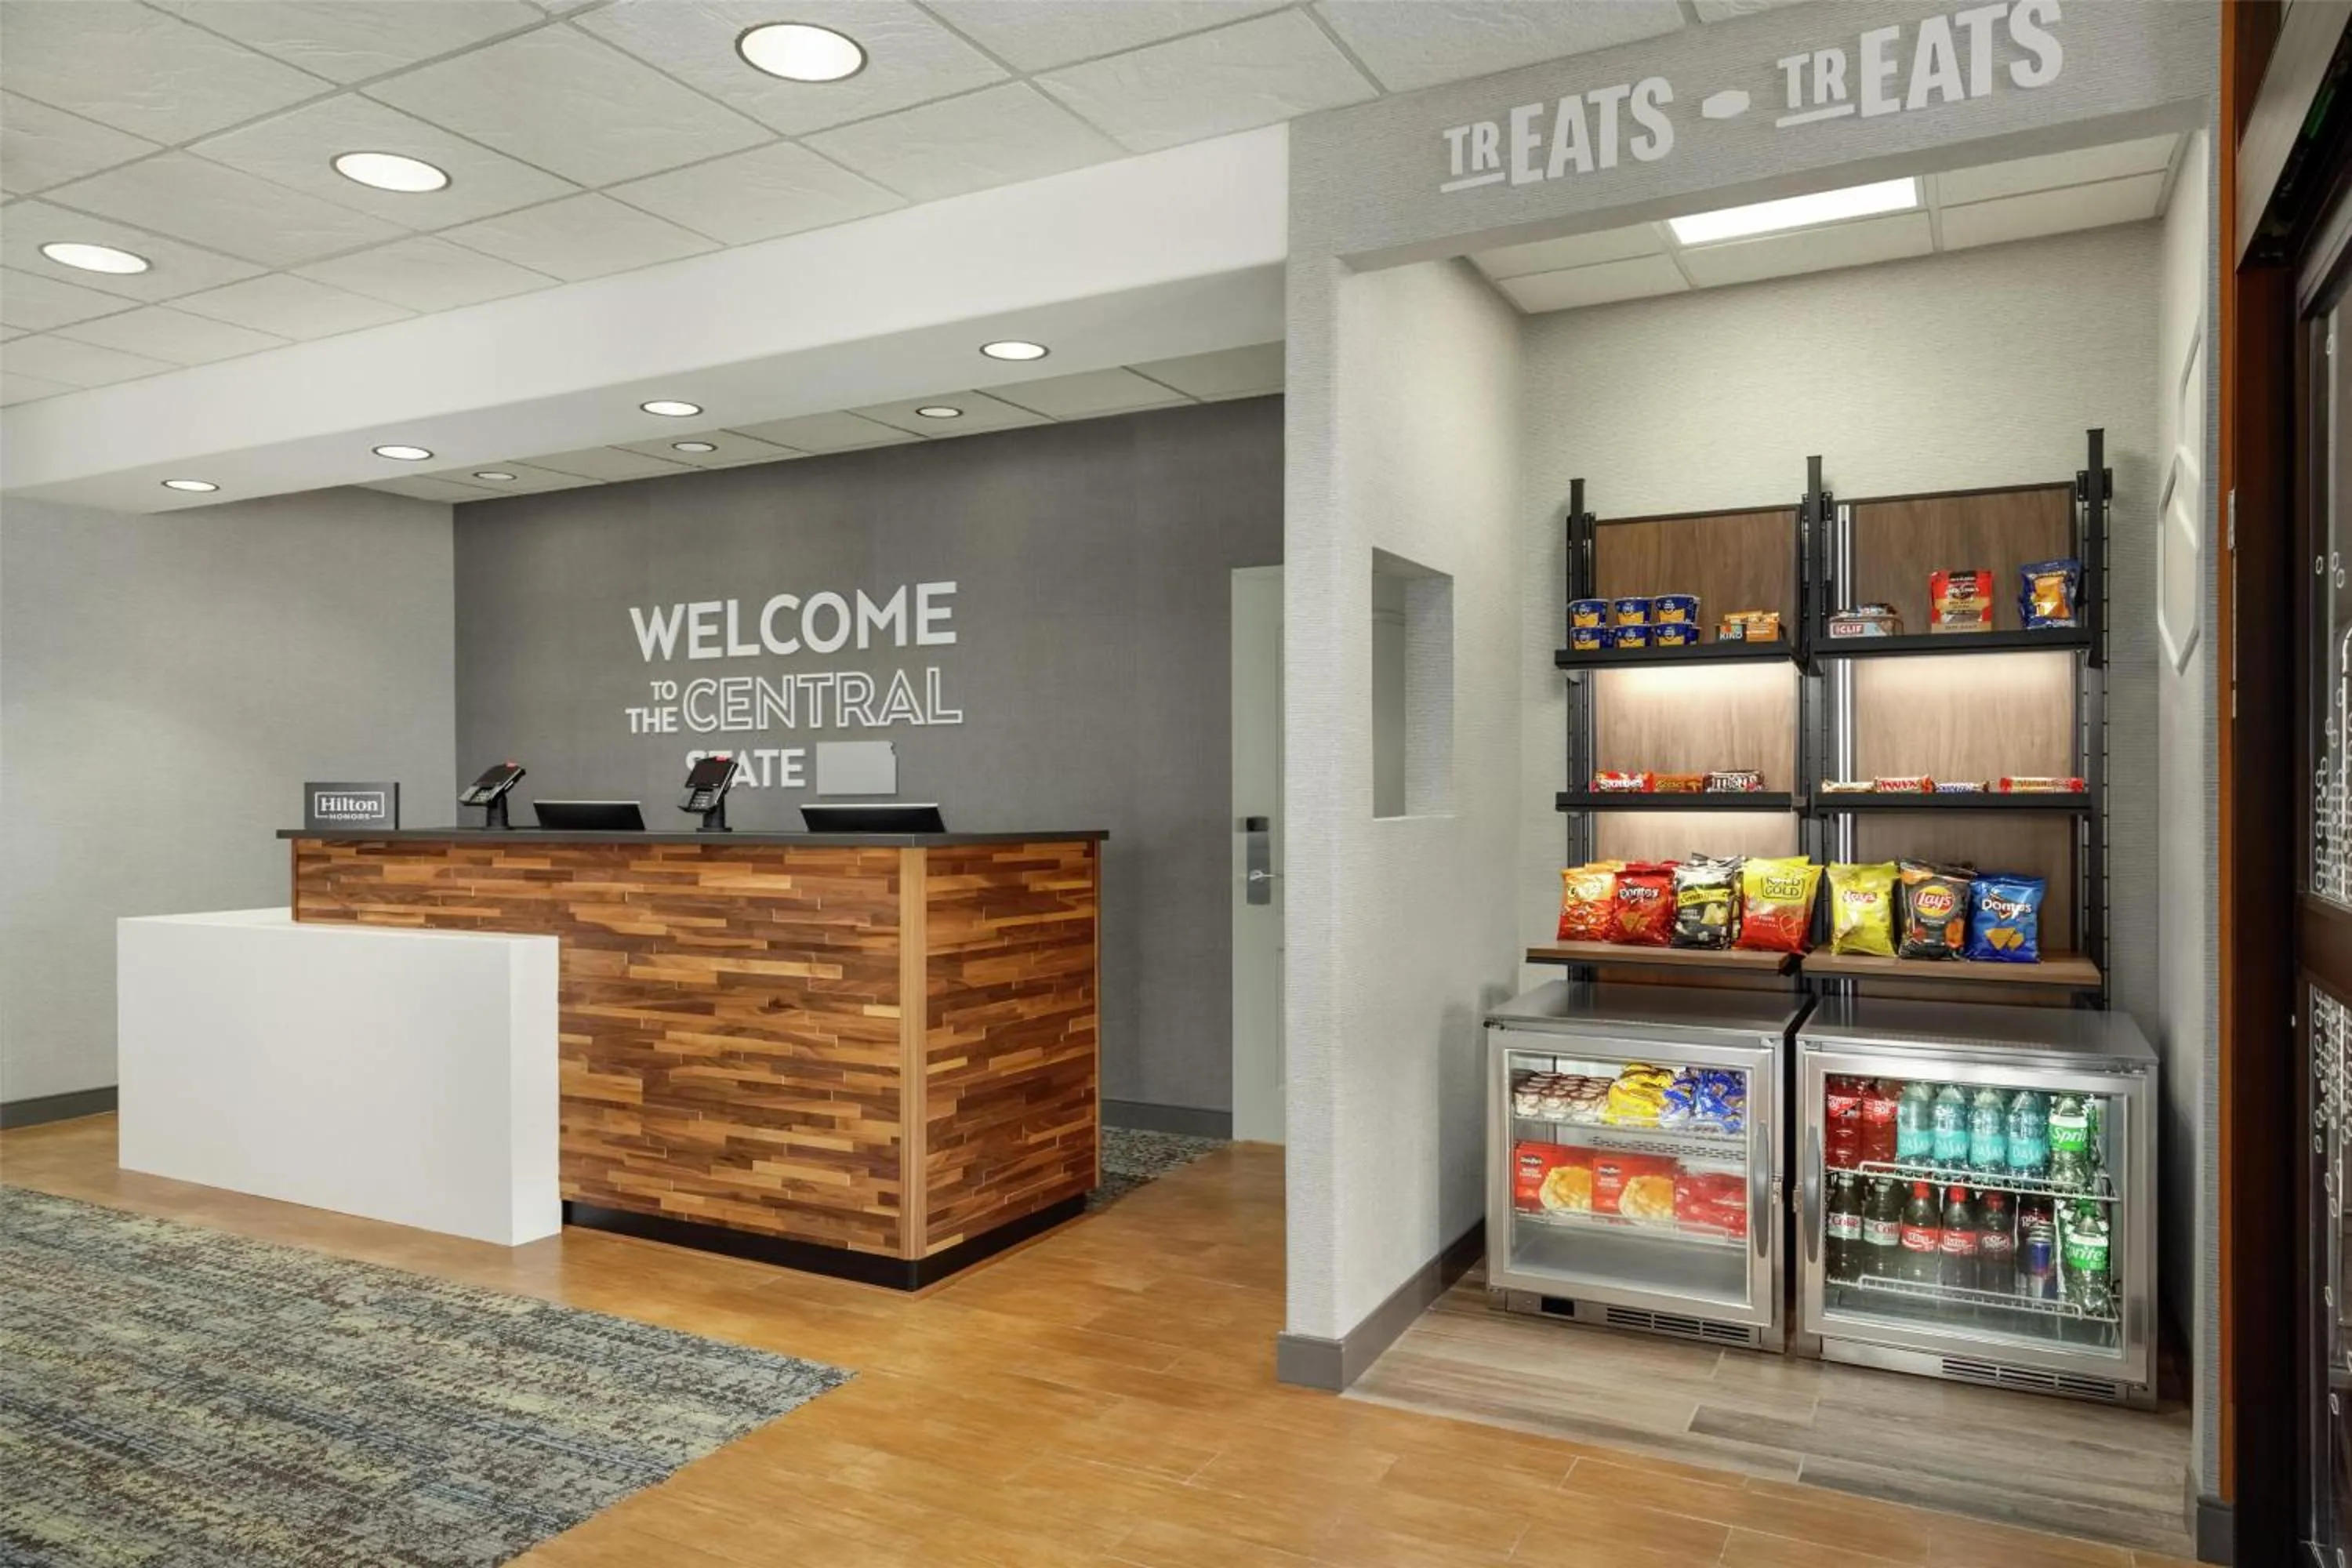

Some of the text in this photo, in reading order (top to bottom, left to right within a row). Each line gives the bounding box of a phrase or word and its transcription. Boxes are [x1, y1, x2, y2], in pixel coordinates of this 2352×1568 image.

[1441, 0, 2064, 192] TREATS TREATS
[629, 581, 958, 662] WELCOME
[1839, 624, 1863, 634] CLIF
[650, 680, 677, 700] TO
[625, 667, 964, 733] THE CENTRAL
[320, 797, 379, 811] Hilton
[1764, 886, 1801, 897] GOLD
[1917, 891, 1952, 909] Lay's
